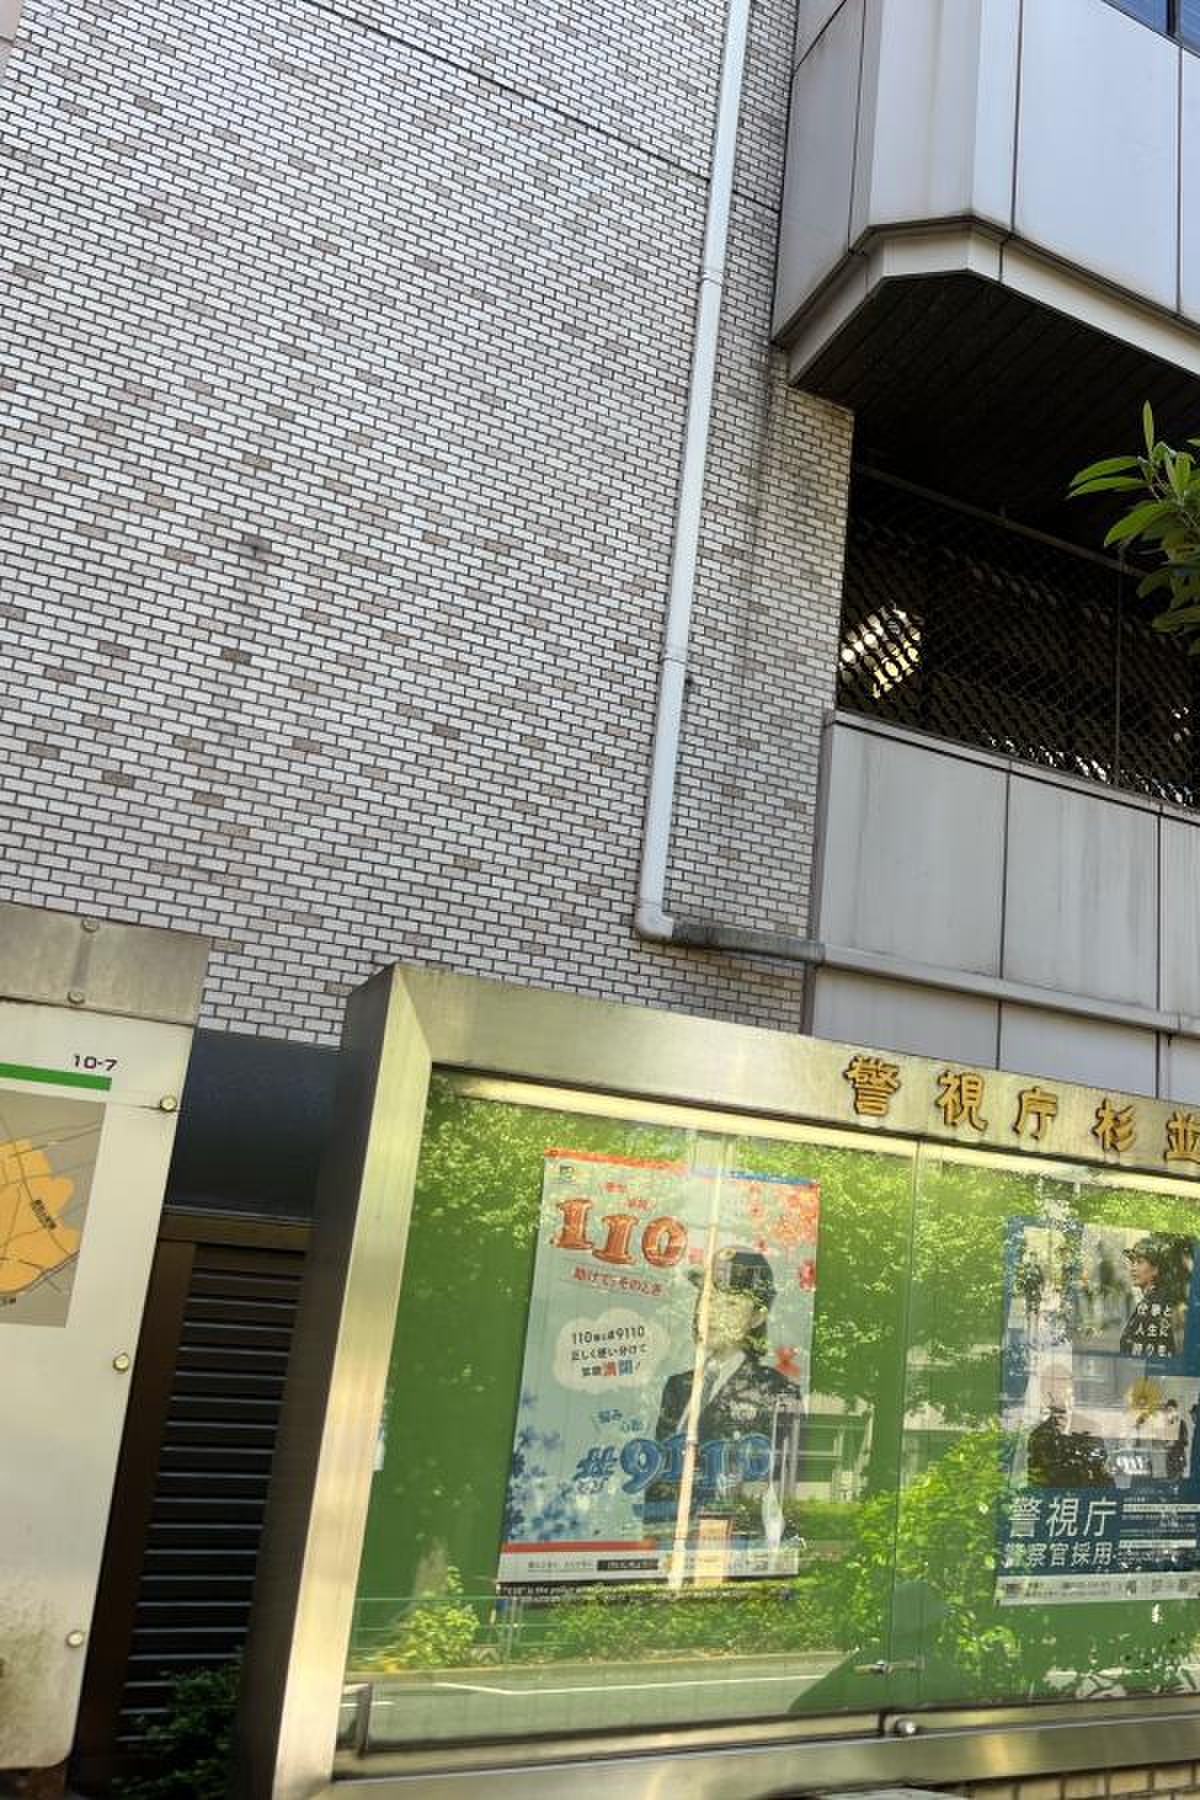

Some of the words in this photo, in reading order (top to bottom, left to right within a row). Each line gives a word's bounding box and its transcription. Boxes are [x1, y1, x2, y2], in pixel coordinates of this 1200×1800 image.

[72, 1053, 118, 1073] 10-7
[550, 1197, 688, 1268] 110
[1008, 1497, 1118, 1538] 警視庁
